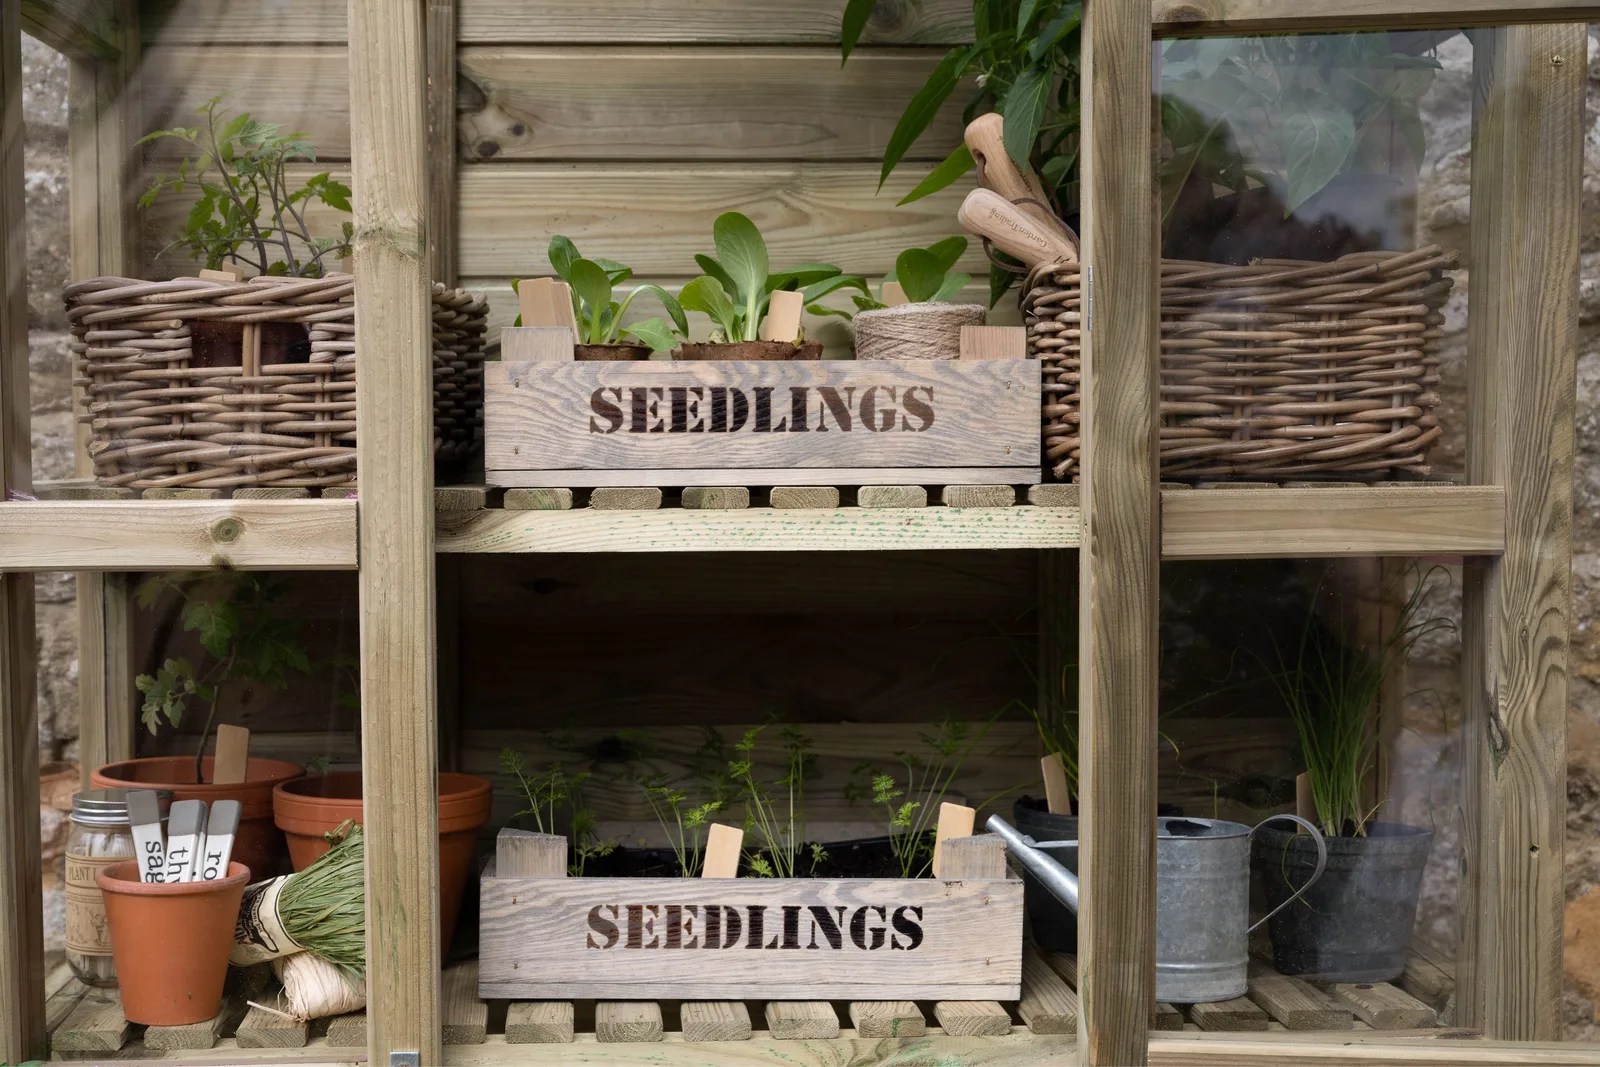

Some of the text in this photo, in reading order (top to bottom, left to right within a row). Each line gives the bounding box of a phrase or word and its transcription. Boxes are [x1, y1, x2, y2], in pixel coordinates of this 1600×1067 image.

[589, 387, 935, 434] SEEDLINGS
[68, 866, 91, 881] PLANT
[167, 846, 190, 884] th
[203, 851, 222, 881] ro
[586, 904, 924, 951] SEEDLINGS
